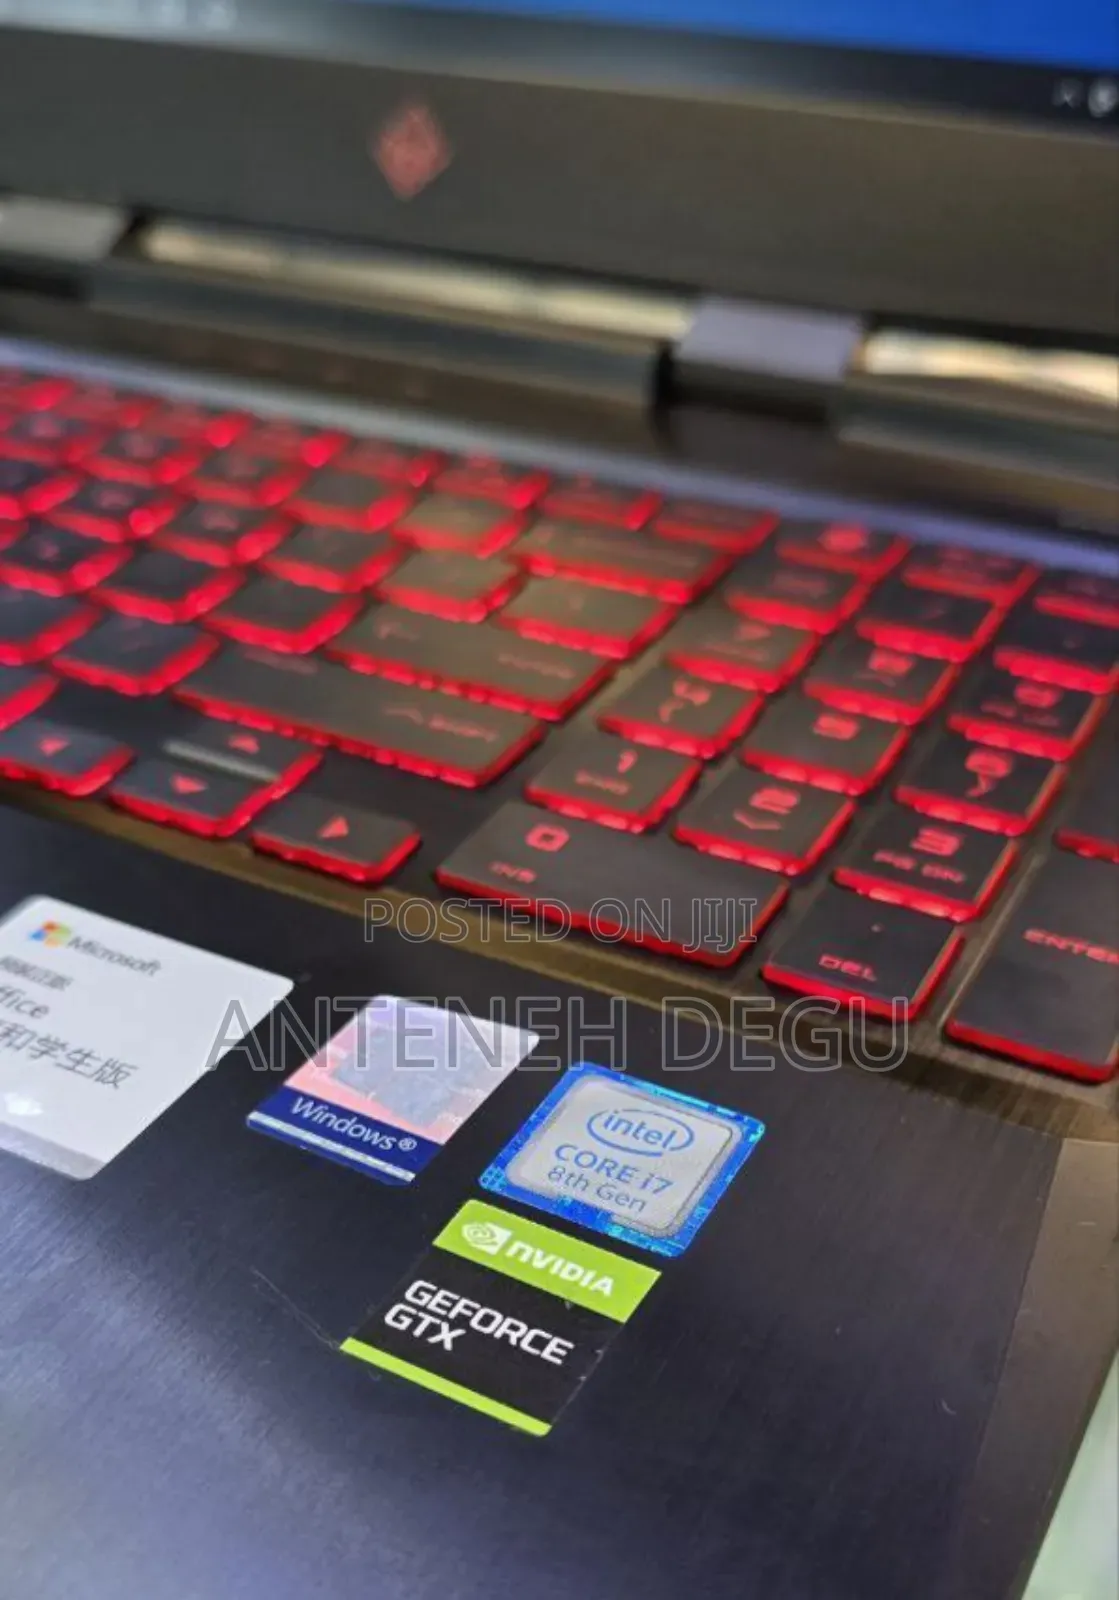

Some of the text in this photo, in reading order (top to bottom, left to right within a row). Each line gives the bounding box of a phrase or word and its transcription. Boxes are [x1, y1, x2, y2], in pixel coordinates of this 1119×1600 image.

[67, 936, 162, 977] Microsoft
[818, 953, 878, 982] DEL
[603, 1109, 677, 1149] intel
[547, 1165, 646, 1212] 8th Gen
[555, 1144, 674, 1195] CORE i7
[384, 1303, 466, 1351] GTX
[404, 1280, 575, 1365] GEFORCE
